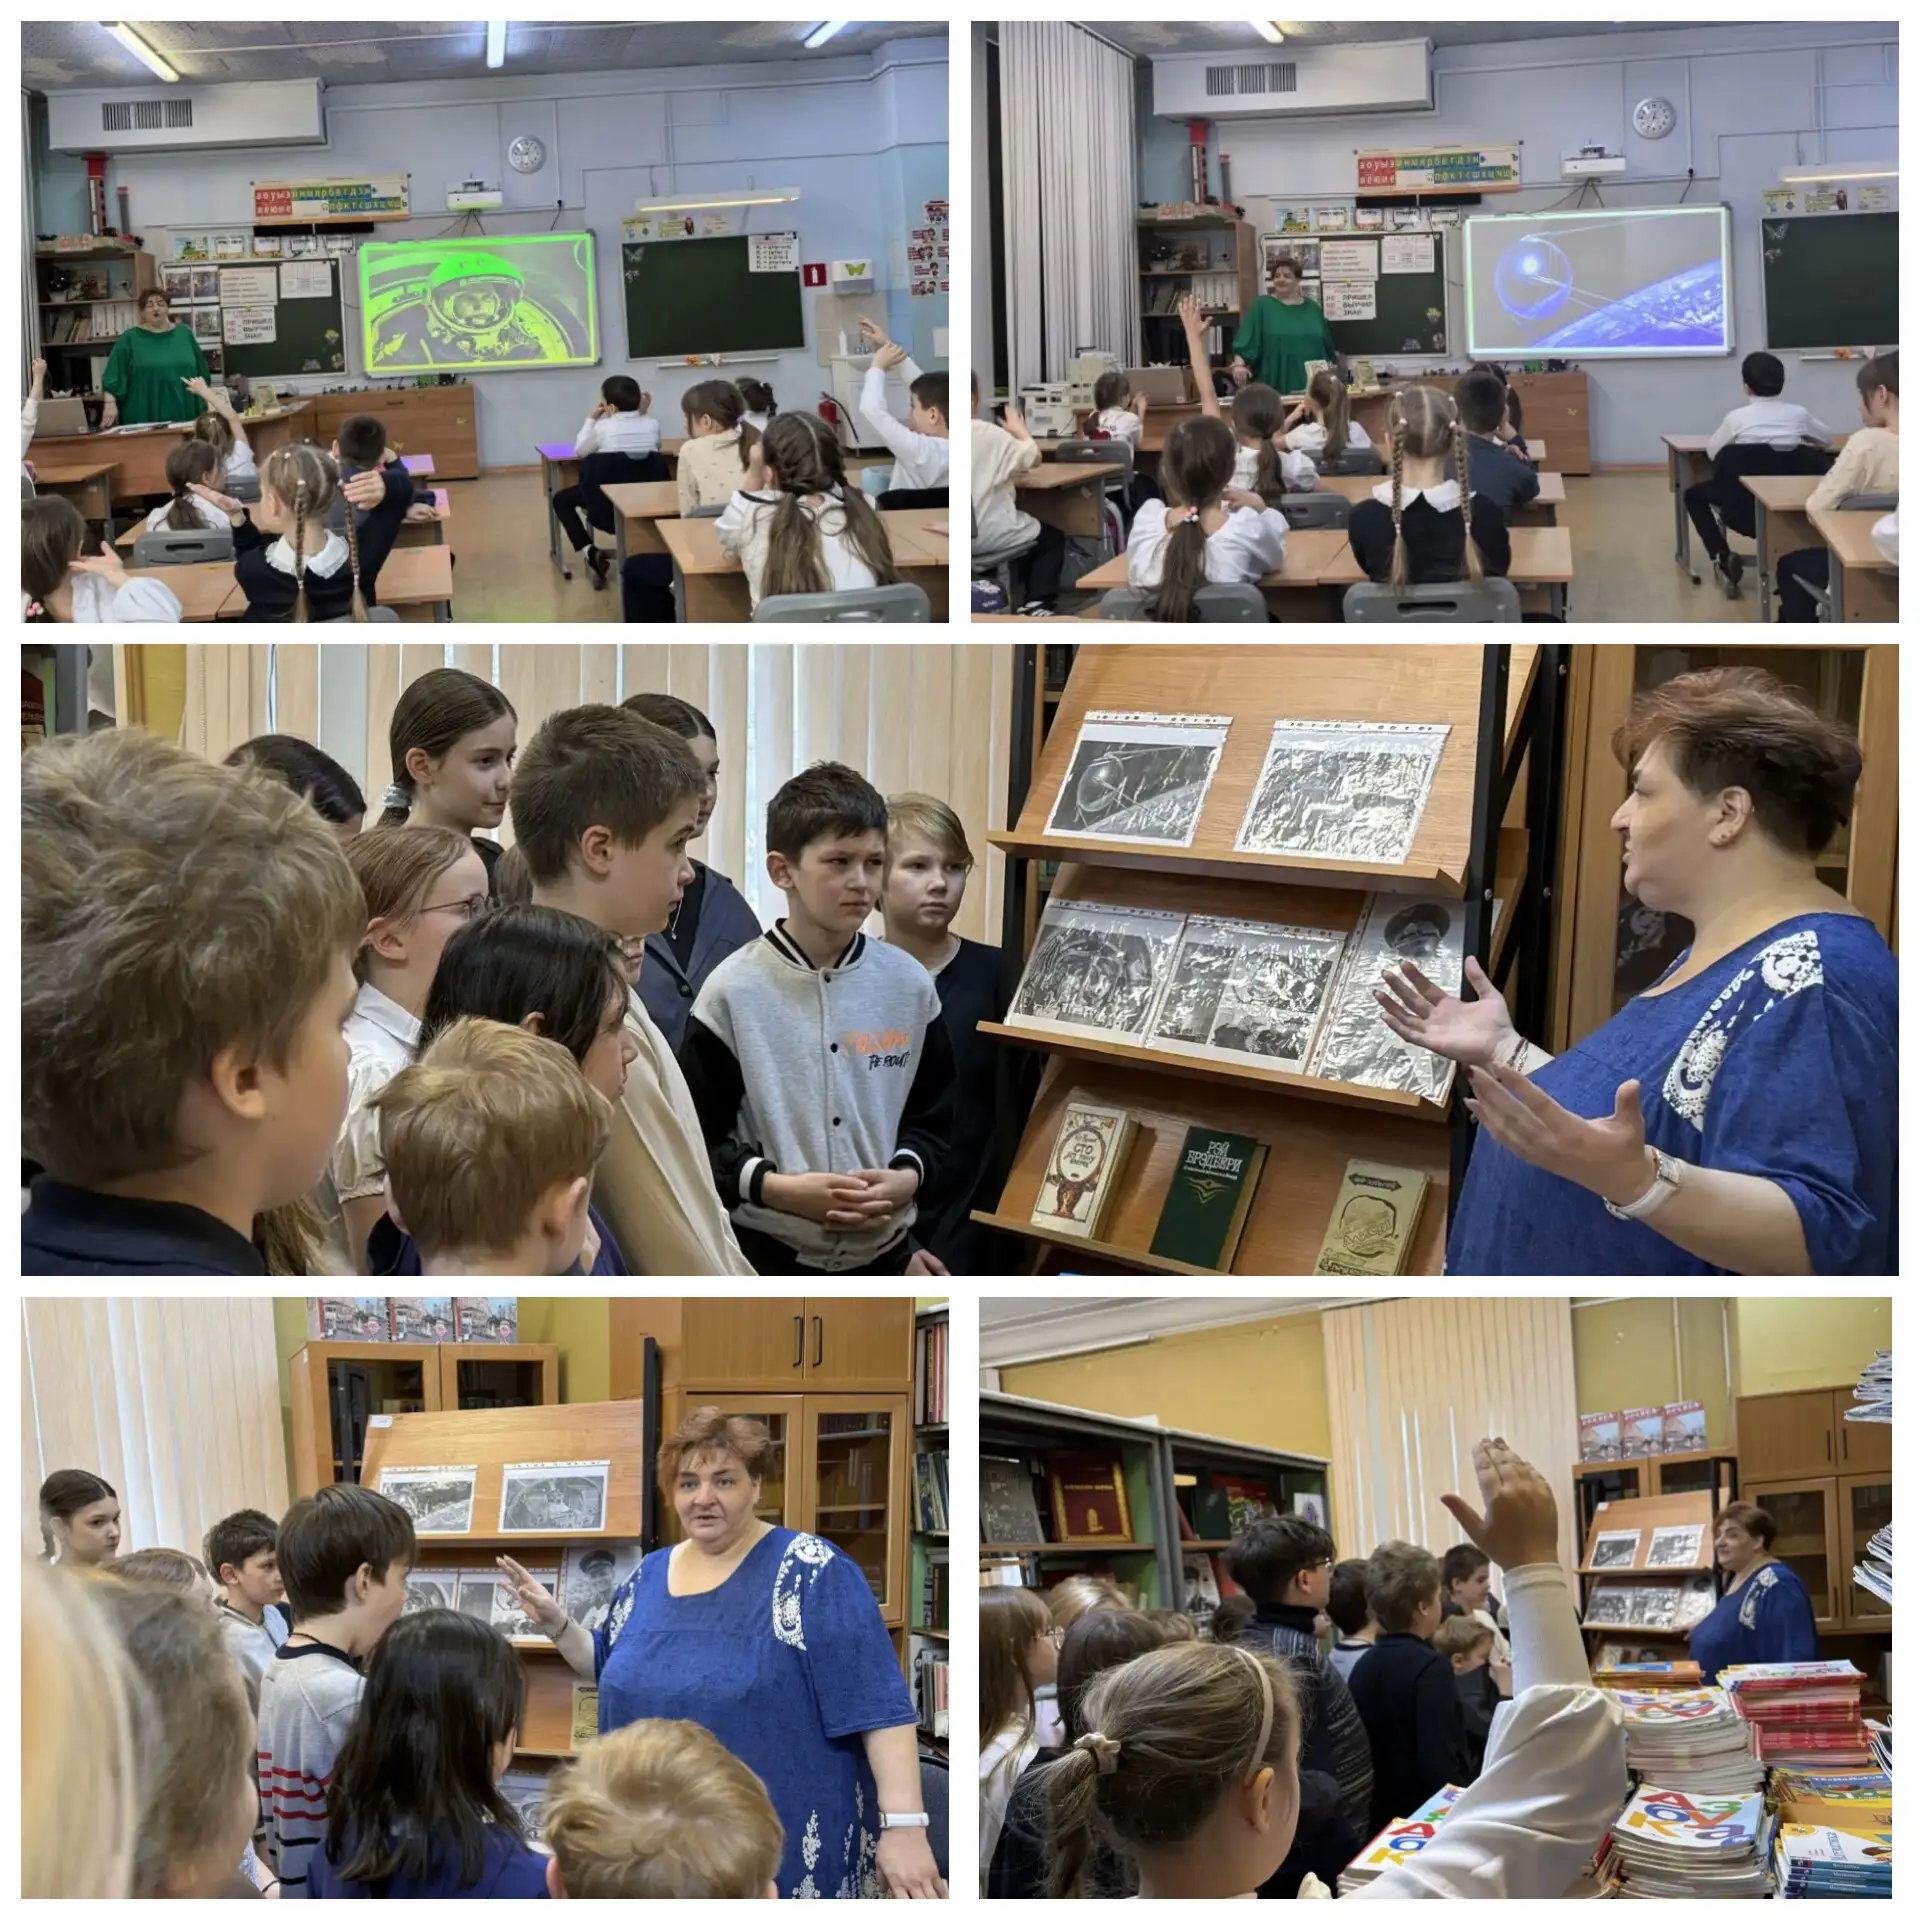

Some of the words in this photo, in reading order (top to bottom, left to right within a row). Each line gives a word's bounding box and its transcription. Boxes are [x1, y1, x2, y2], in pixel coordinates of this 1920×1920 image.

[1073, 1143, 1094, 1155] СТО
[1206, 1140, 1231, 1158] РЭЙ
[1185, 1149, 1244, 1173] БРЭДБЕРИ
